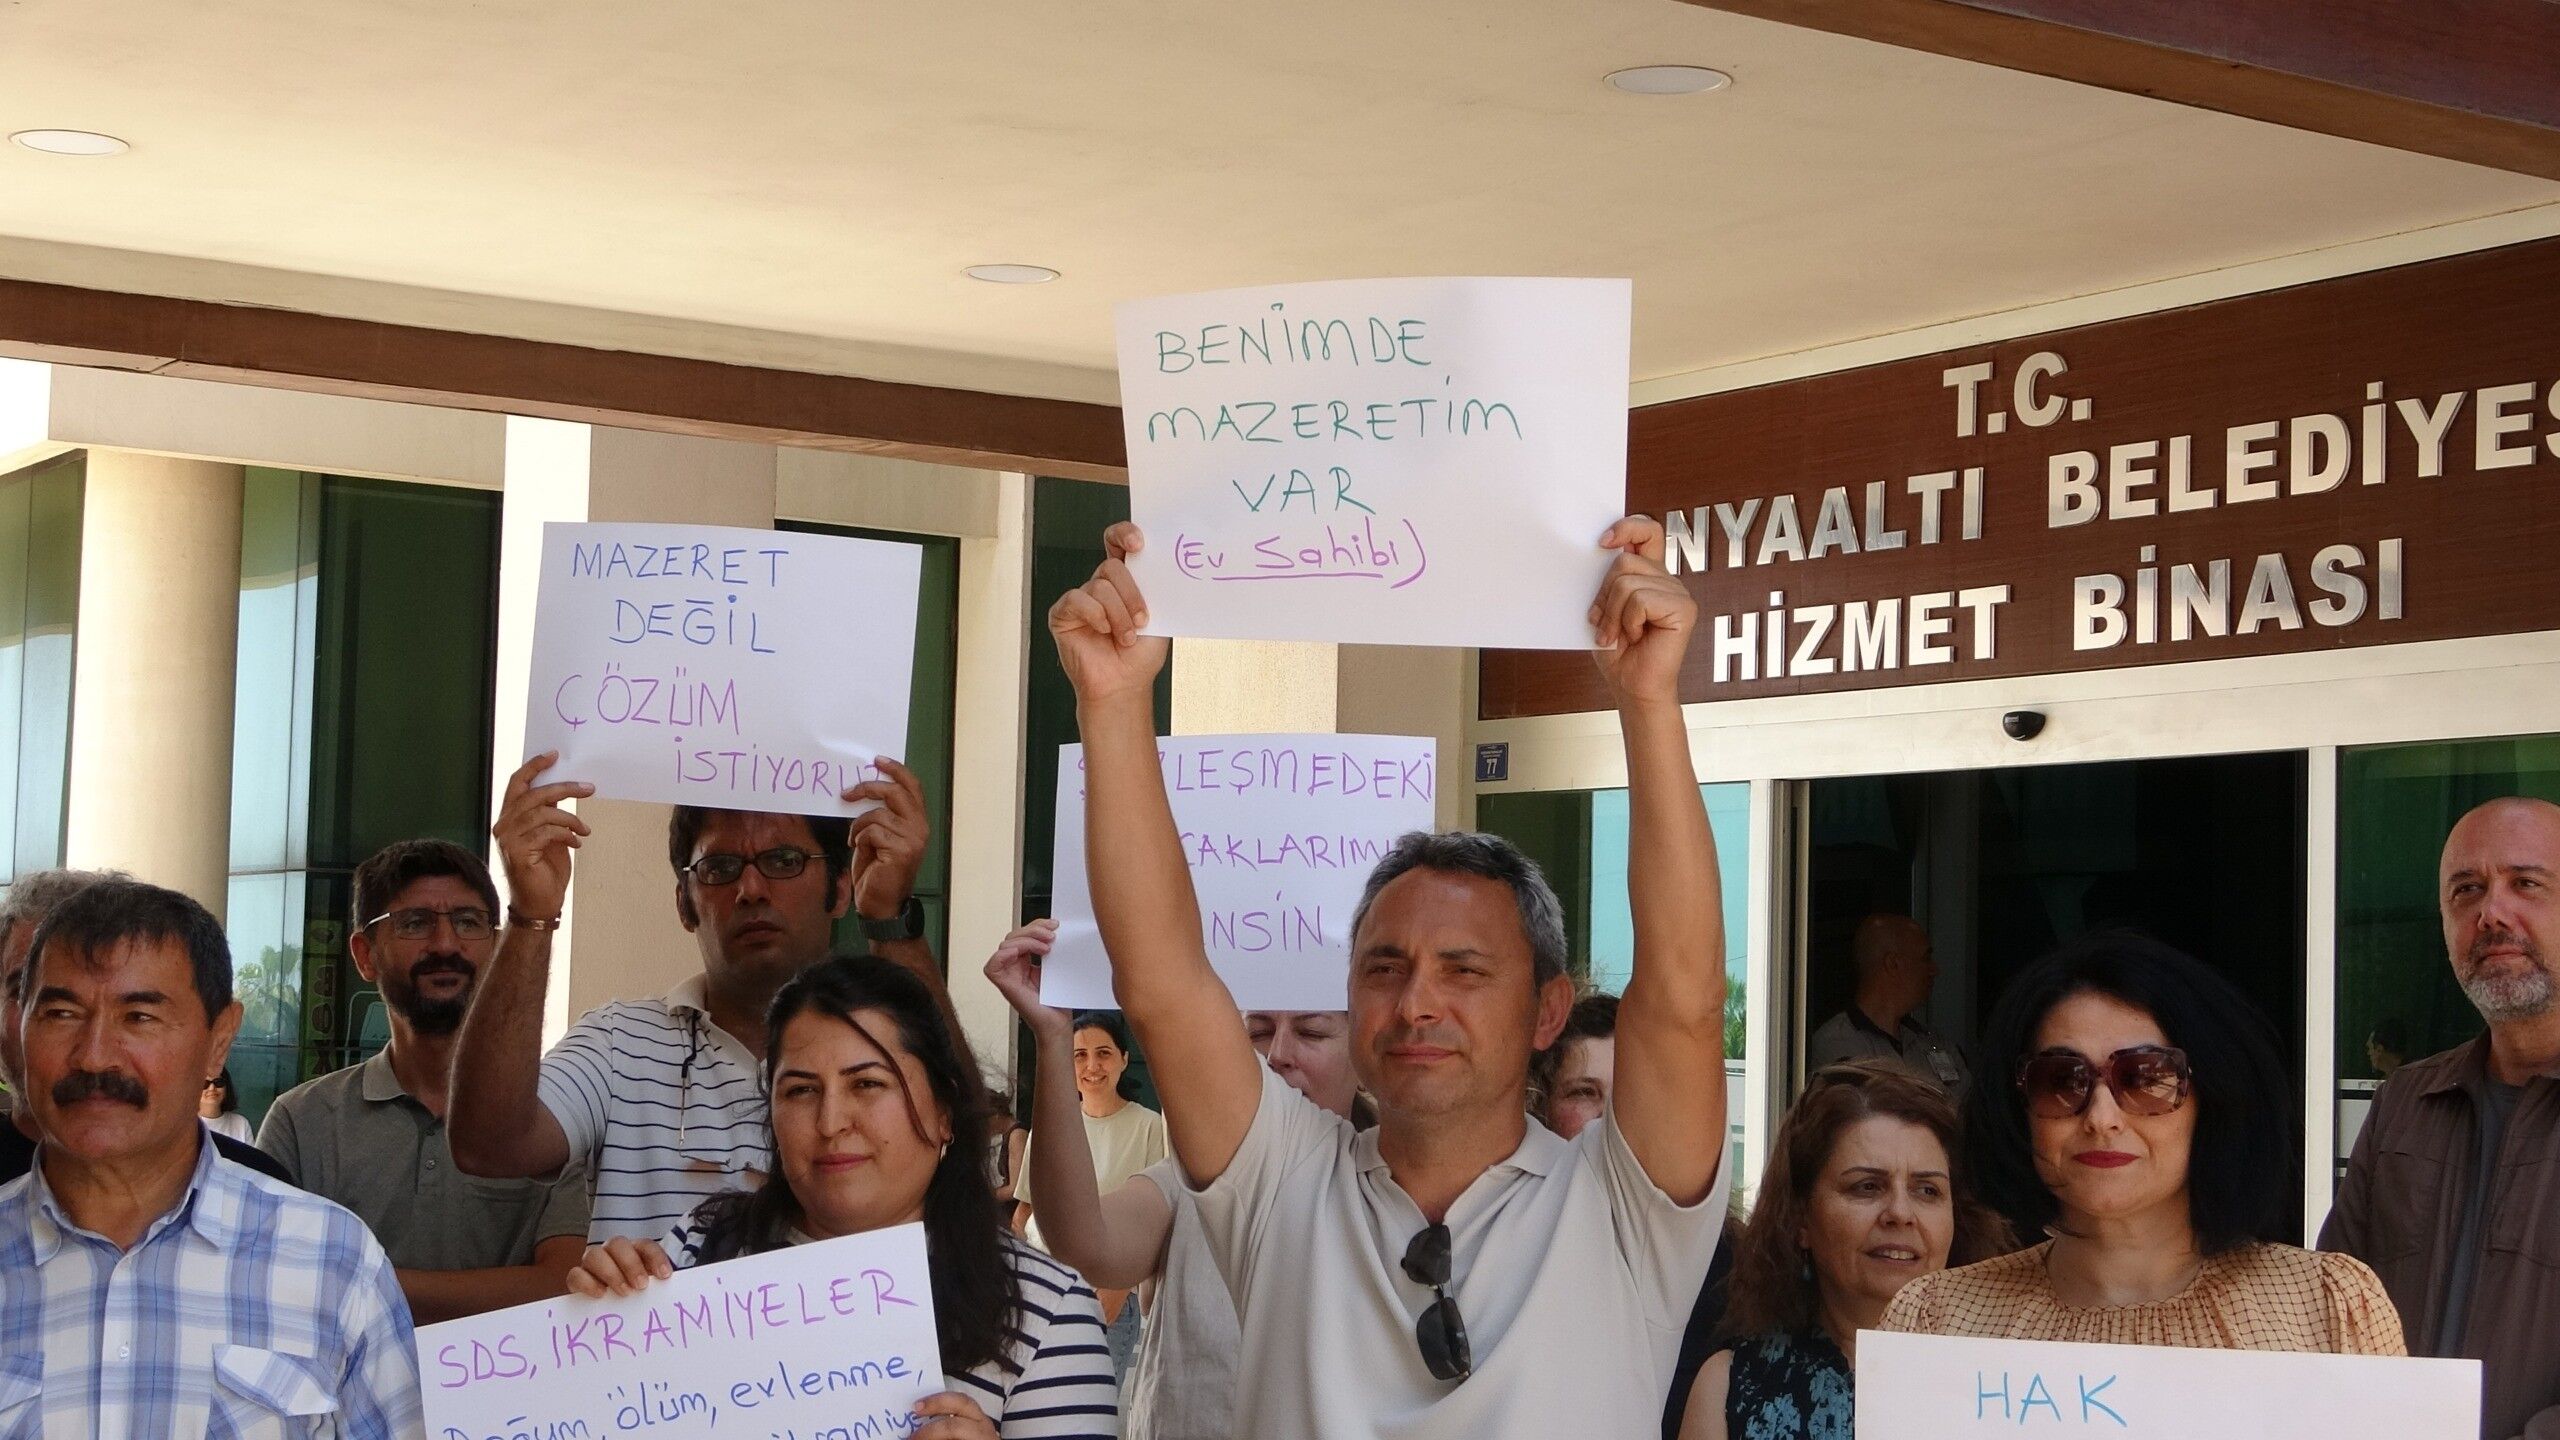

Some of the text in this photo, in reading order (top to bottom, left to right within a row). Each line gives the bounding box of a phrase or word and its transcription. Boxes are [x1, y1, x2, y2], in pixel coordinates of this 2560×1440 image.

[1148, 375, 1523, 442] MAZERETİM
[1943, 351, 2092, 437] T.C.
[1232, 466, 1376, 515] VAR
[1665, 379, 2560, 576] NYAALTI BELEDİYE
[572, 543, 789, 587] MAZERET
[608, 594, 775, 653] DEĞİL
[1713, 537, 2404, 683] HİZMET BİNASI
[555, 662, 739, 736] ÇÖZÜM
[1077, 749, 1432, 802] LEŞMEDEKİ
[1211, 890, 1342, 952] NSİN.
[547, 1269, 917, 1369] İKRAMİYELER
[731, 1356, 923, 1408] evlenme,
[1977, 1371, 2127, 1427] HAK
